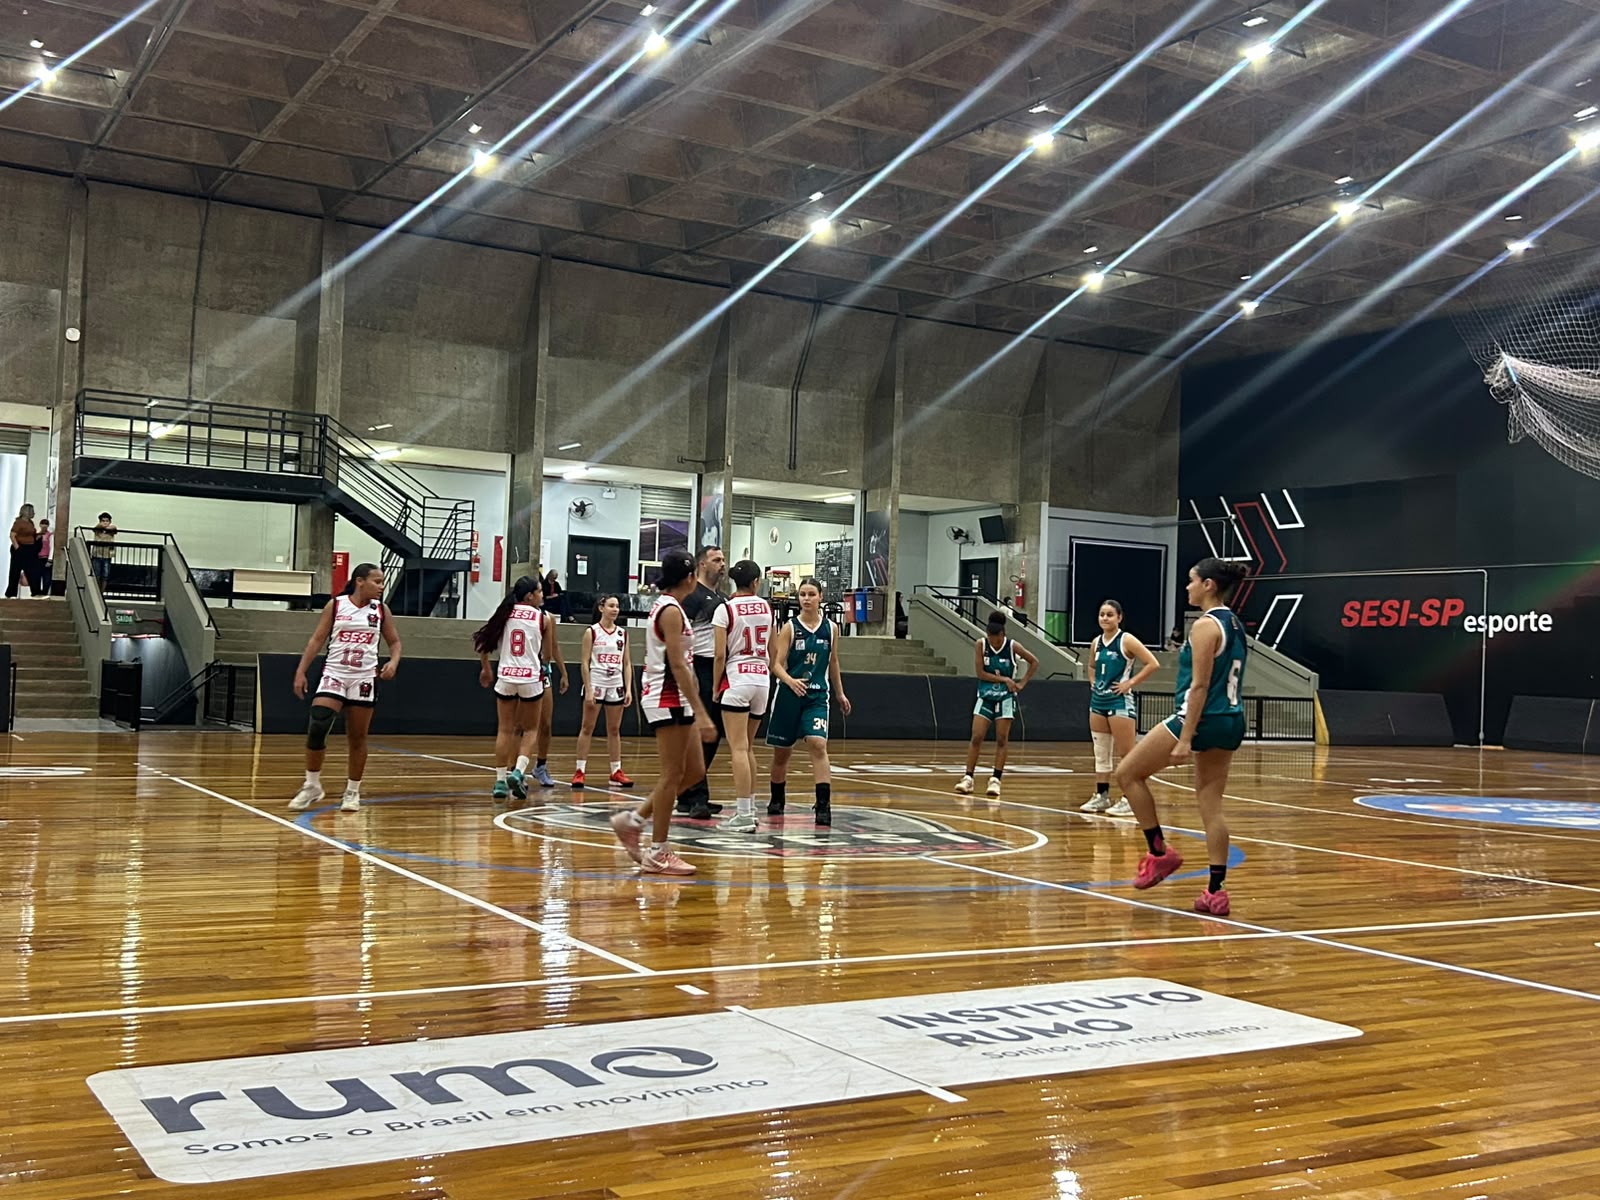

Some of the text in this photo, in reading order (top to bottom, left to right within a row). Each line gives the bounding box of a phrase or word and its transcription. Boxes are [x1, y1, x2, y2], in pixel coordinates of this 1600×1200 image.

[740, 603, 765, 614] SESI
[1341, 598, 1553, 638] SESI-SP esporte
[341, 632, 372, 643] SESI
[510, 629, 525, 657] 8
[741, 625, 768, 657] 15
[340, 647, 365, 668] 12
[600, 654, 621, 664] SESI
[804, 652, 817, 665] 34
[503, 667, 531, 677] FIESP
[741, 664, 767, 674] FIESP
[813, 717, 827, 732] 34
[877, 990, 1203, 1030] INSTITUTO
[927, 1018, 1133, 1047] RUMO
[981, 1042, 1082, 1060] Sonhos
[1085, 1039, 1129, 1049] em
[140, 1046, 719, 1134] rumo
[183, 1079, 769, 1155] Somos o Brasil em movimento
